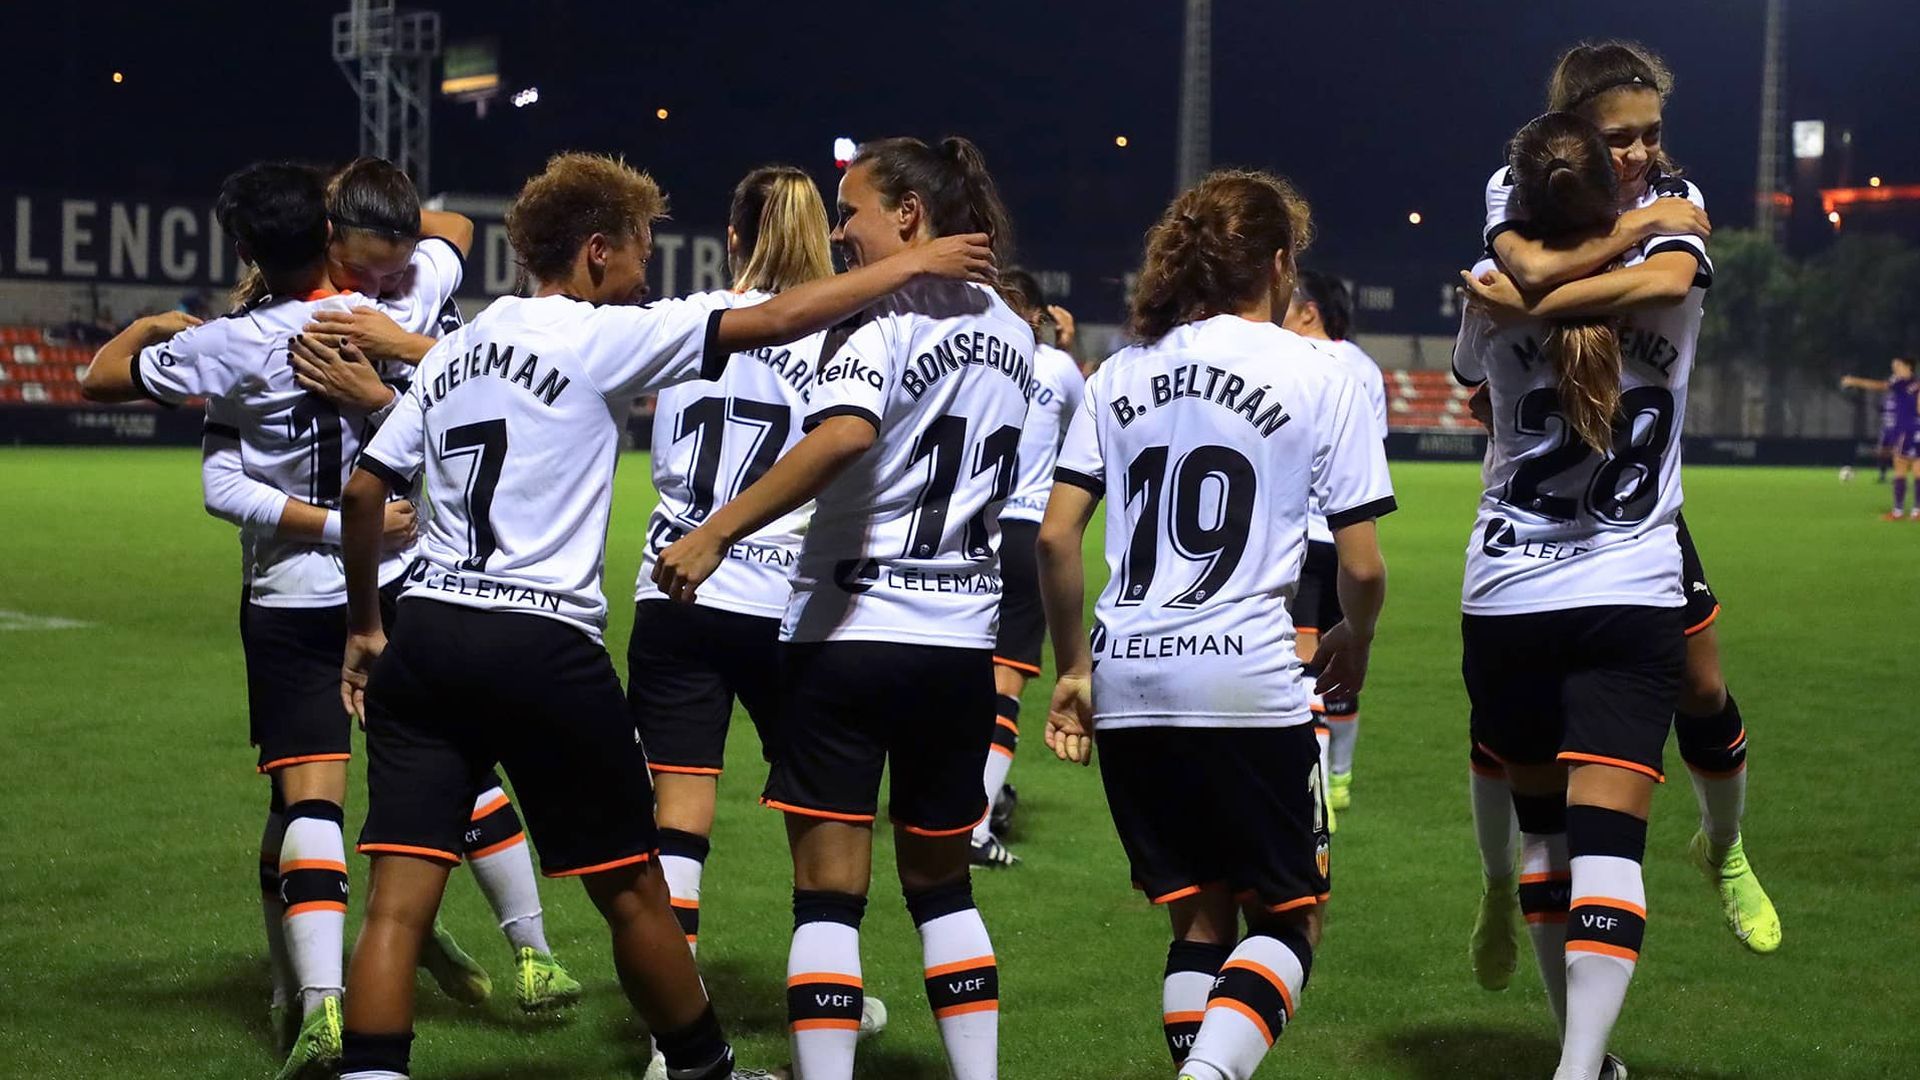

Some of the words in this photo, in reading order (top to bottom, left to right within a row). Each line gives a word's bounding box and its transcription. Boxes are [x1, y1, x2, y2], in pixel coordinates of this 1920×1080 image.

[0, 197, 246, 283] LENCI
[816, 356, 884, 392] teika
[1110, 395, 1148, 429] B.
[1150, 363, 1292, 439] BELTRÁN
[439, 417, 509, 573] 7
[673, 396, 791, 529] 17
[904, 413, 1022, 561] 11
[1498, 385, 1676, 527] 28
[1114, 444, 1258, 610] 19
[1581, 914, 1618, 931] VCF
[815, 993, 854, 1008] VCF
[949, 977, 986, 994] VCF
